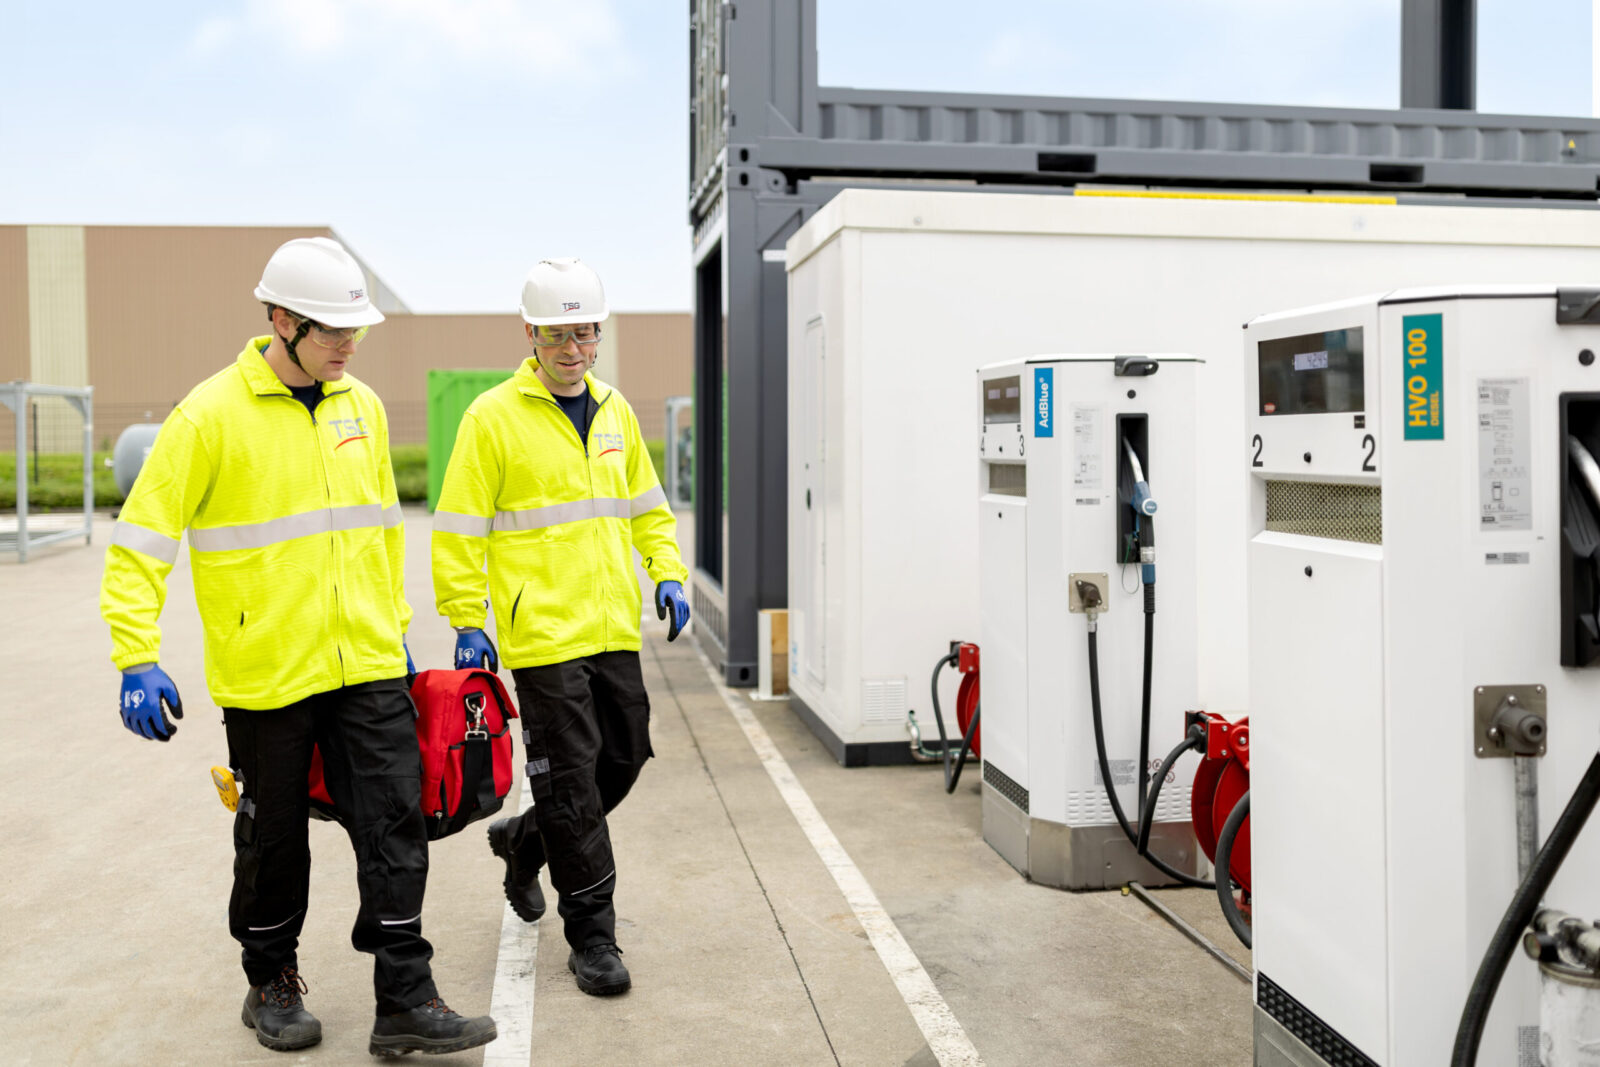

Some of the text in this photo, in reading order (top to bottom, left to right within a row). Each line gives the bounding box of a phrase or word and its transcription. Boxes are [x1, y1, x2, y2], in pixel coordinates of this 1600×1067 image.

[562, 302, 580, 311] TSG
[1408, 328, 1427, 426] HVO 100
[1430, 390, 1439, 426] DIESEL
[593, 433, 624, 450] TSG
[1019, 434, 1025, 457] 3
[1252, 433, 1264, 467] 2
[1361, 433, 1377, 472] 2
